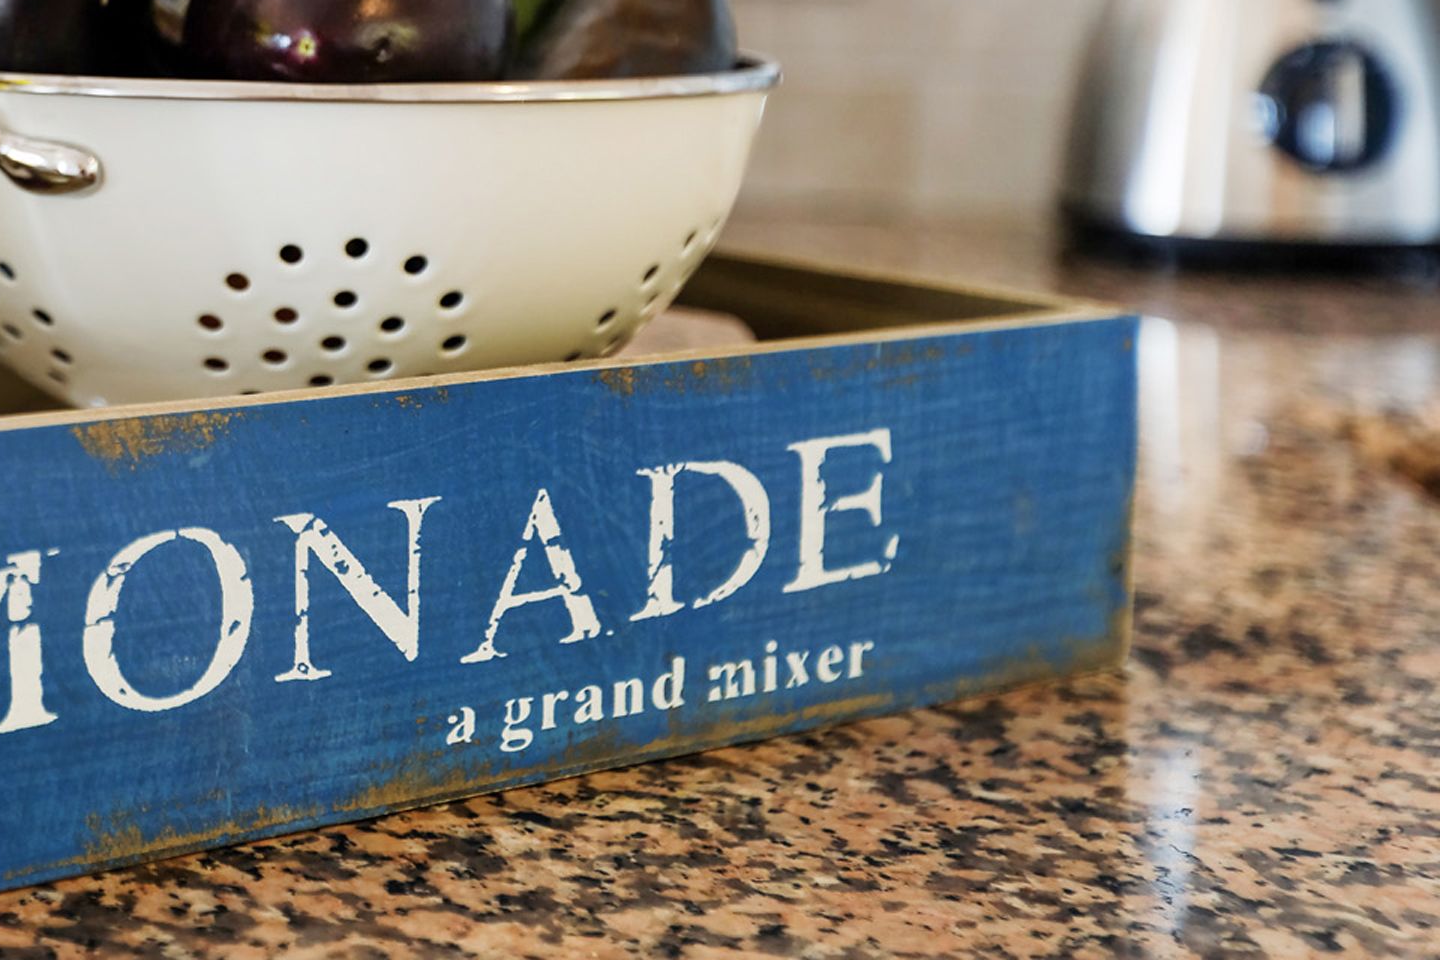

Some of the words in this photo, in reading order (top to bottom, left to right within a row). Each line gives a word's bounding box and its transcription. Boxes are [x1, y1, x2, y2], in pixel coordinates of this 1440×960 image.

[446, 704, 476, 745] a
[500, 655, 685, 752] grand
[707, 638, 876, 701] mixer
